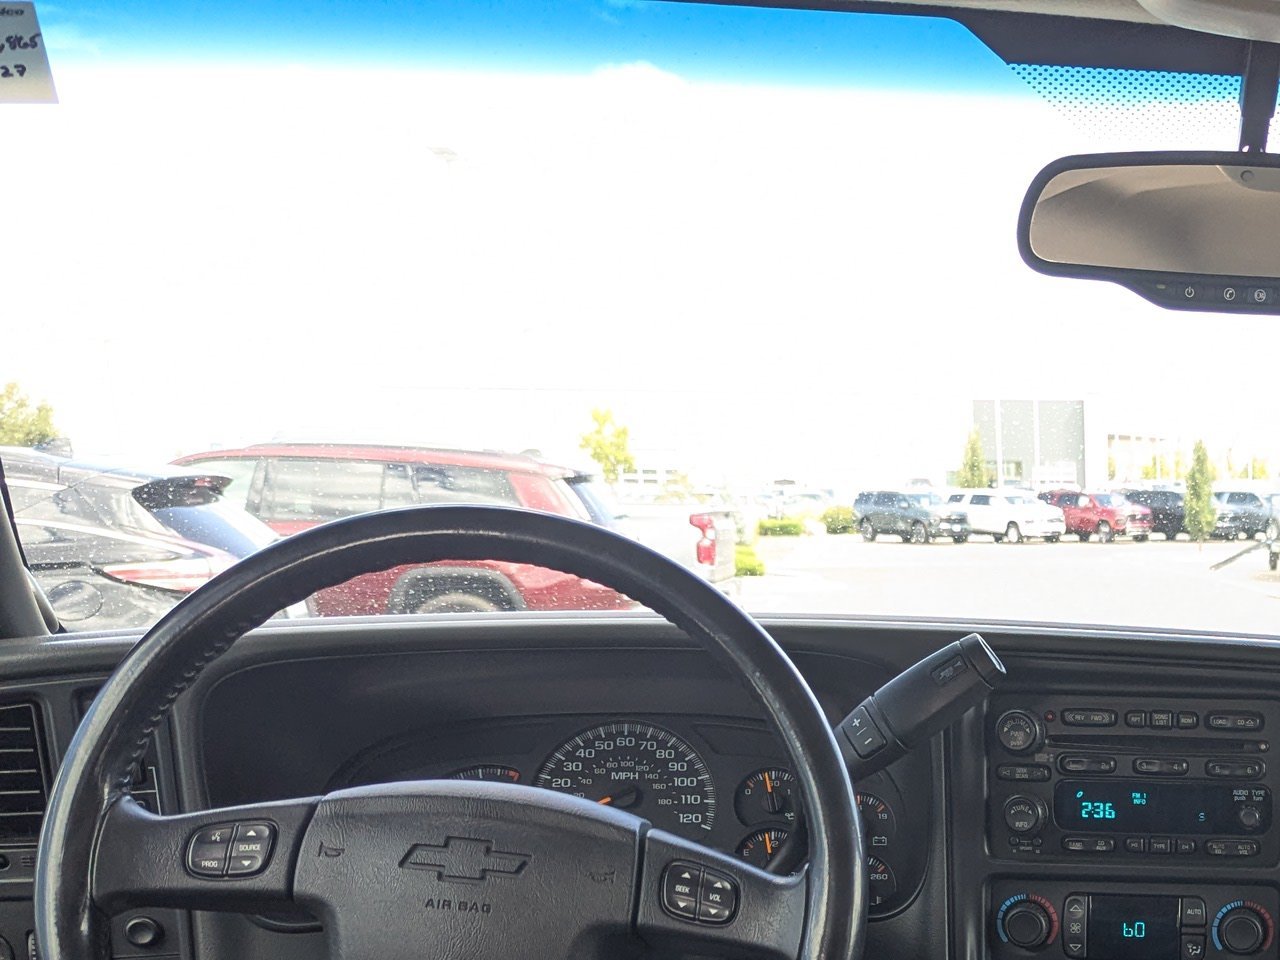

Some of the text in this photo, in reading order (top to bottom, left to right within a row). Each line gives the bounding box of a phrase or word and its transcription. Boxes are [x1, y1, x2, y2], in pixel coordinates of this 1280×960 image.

[594, 741, 614, 751] 50
[616, 737, 636, 747] 60
[638, 741, 657, 751] 70
[575, 748, 595, 758] 40
[655, 749, 675, 759] 80
[563, 761, 582, 772] 30
[668, 762, 688, 772] 90
[611, 772, 639, 780] MPH
[552, 778, 571, 788] 20
[673, 777, 697, 787] 100
[681, 795, 701, 805] 110
[1012, 804, 1030, 812] TUNE
[1081, 802, 1115, 818] 2:36
[679, 813, 702, 823] 120
[239, 843, 261, 851] SOURCE
[743, 849, 750, 857] E
[201, 860, 218, 868] PROG
[675, 884, 690, 894] SEEK
[709, 893, 721, 902] VOL
[425, 897, 492, 914] AIR BAG
[1186, 907, 1202, 915] AUTO
